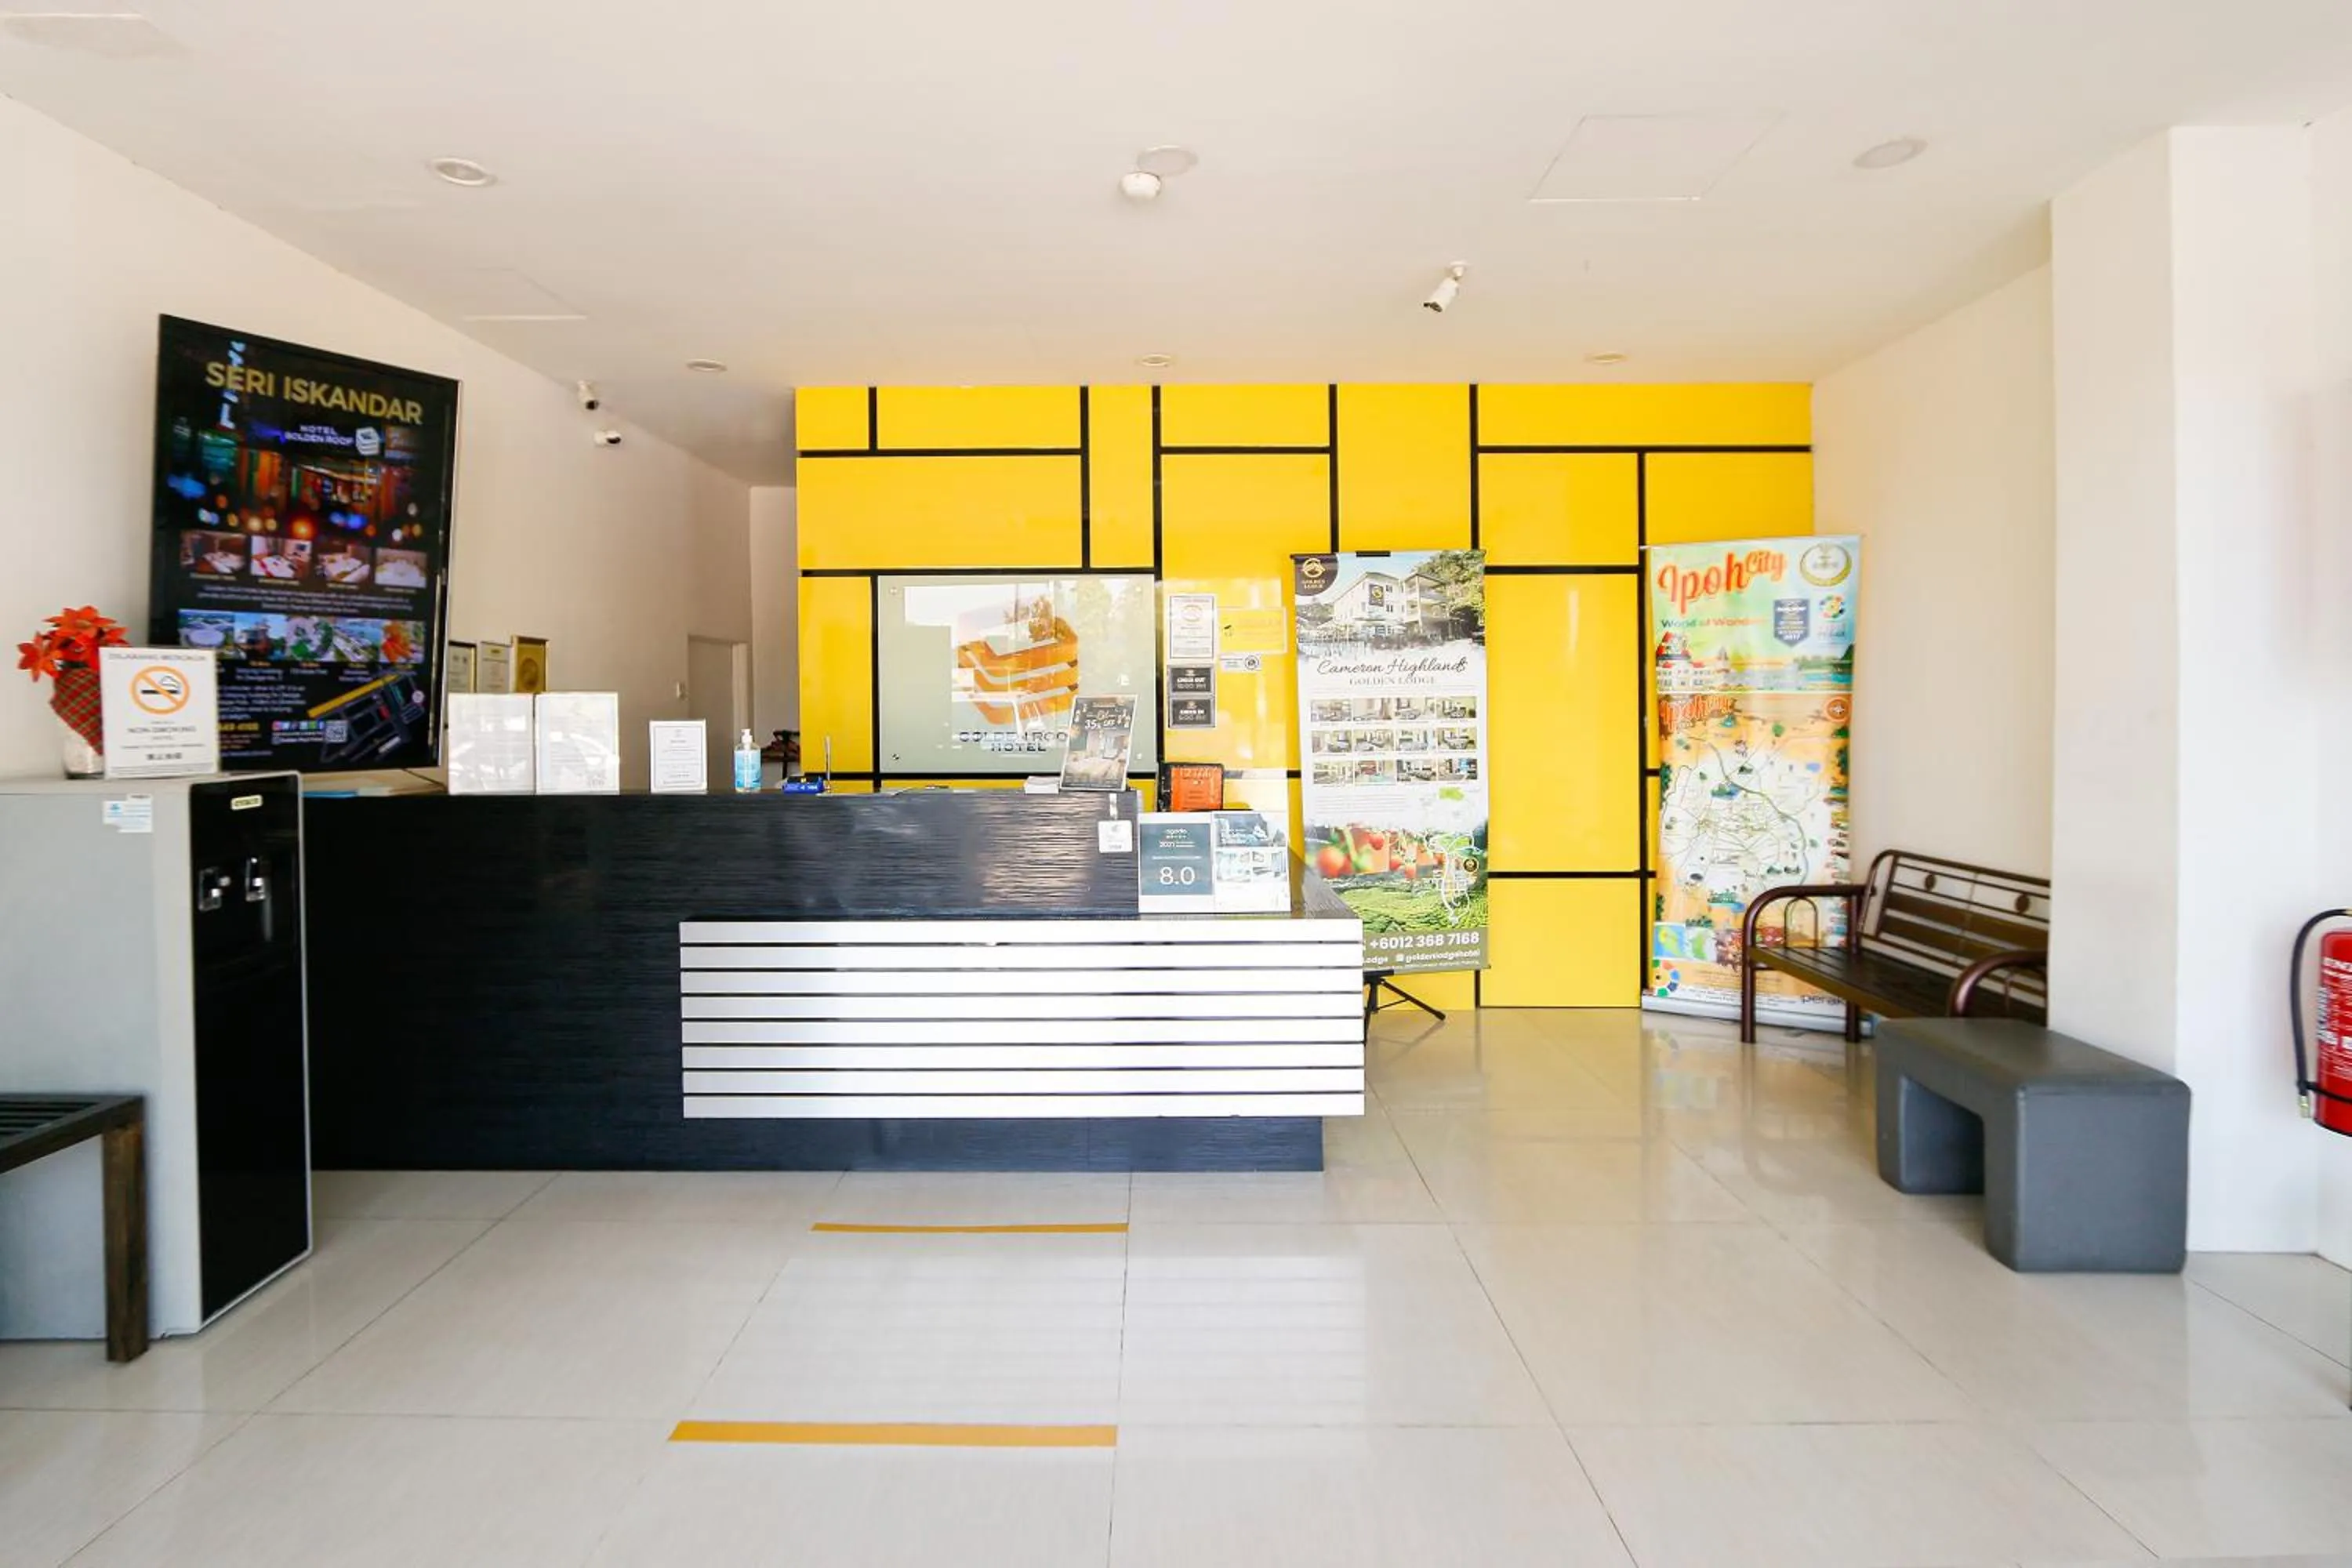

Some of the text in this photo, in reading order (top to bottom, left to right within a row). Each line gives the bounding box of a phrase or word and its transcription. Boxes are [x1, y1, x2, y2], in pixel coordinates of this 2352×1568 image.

[205, 361, 275, 398] SERI
[283, 376, 424, 425] ISKANDAR
[1317, 659, 1385, 675] Cameron
[1031, 731, 1068, 742] ROO
[990, 742, 1047, 752] HOTEL
[1160, 866, 1196, 886] 8.0
[1370, 935, 1414, 949] +6012
